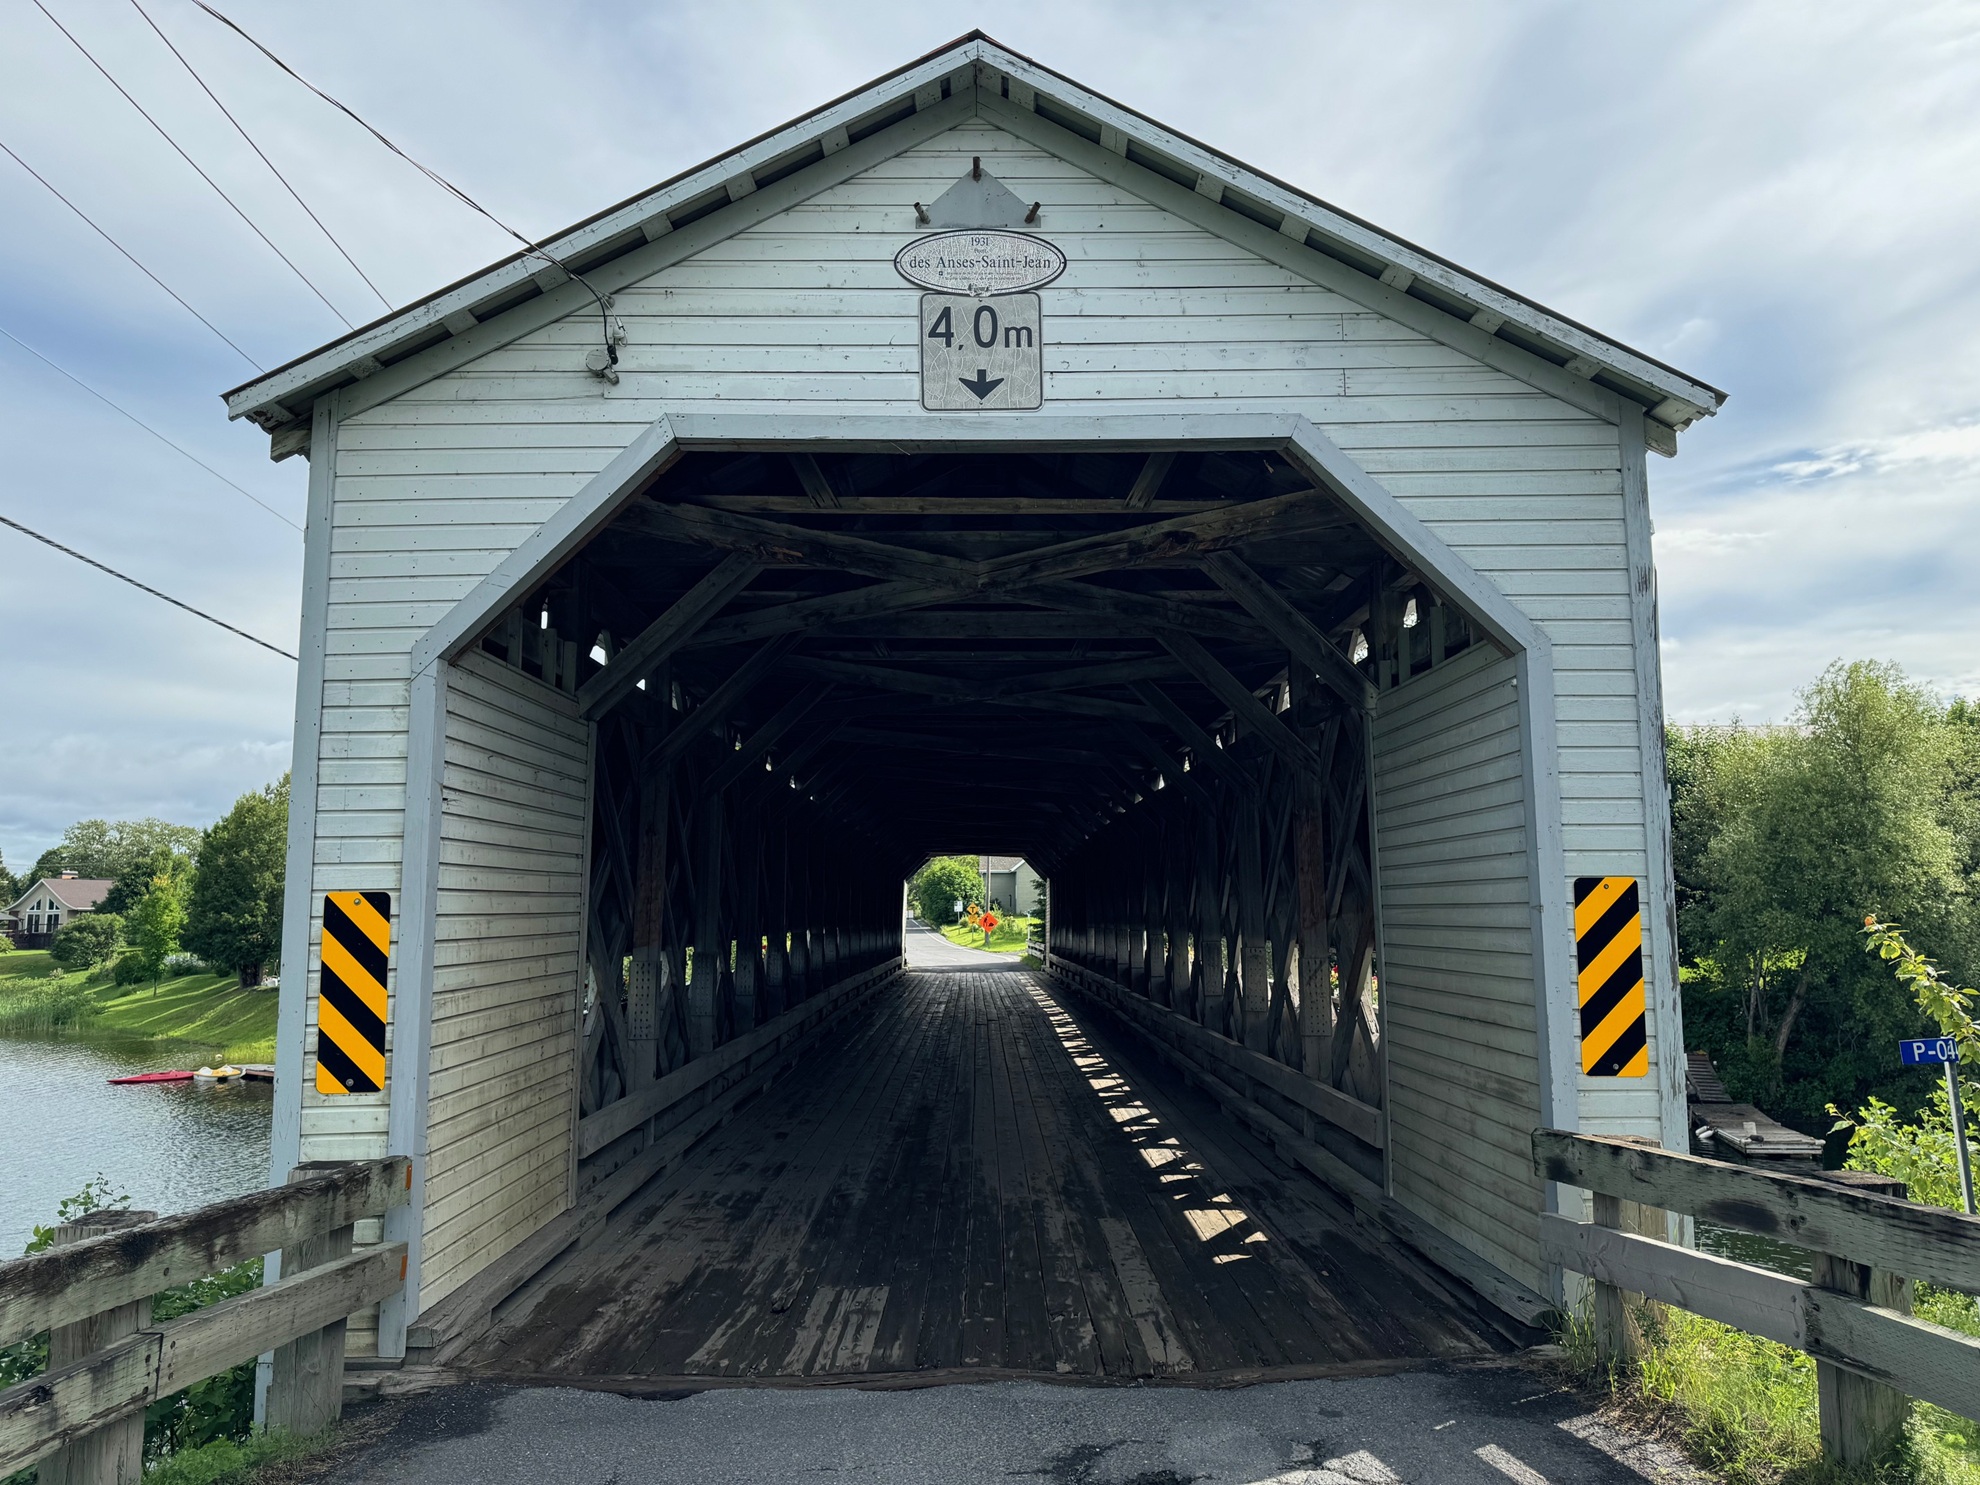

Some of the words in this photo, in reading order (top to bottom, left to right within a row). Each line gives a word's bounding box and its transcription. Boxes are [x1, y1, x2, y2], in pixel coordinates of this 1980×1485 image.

[970, 237, 989, 246] 1931
[909, 256, 931, 268] des
[936, 255, 1051, 269] Anses-Saint-Jean
[1912, 1040, 1958, 1062] P-04
